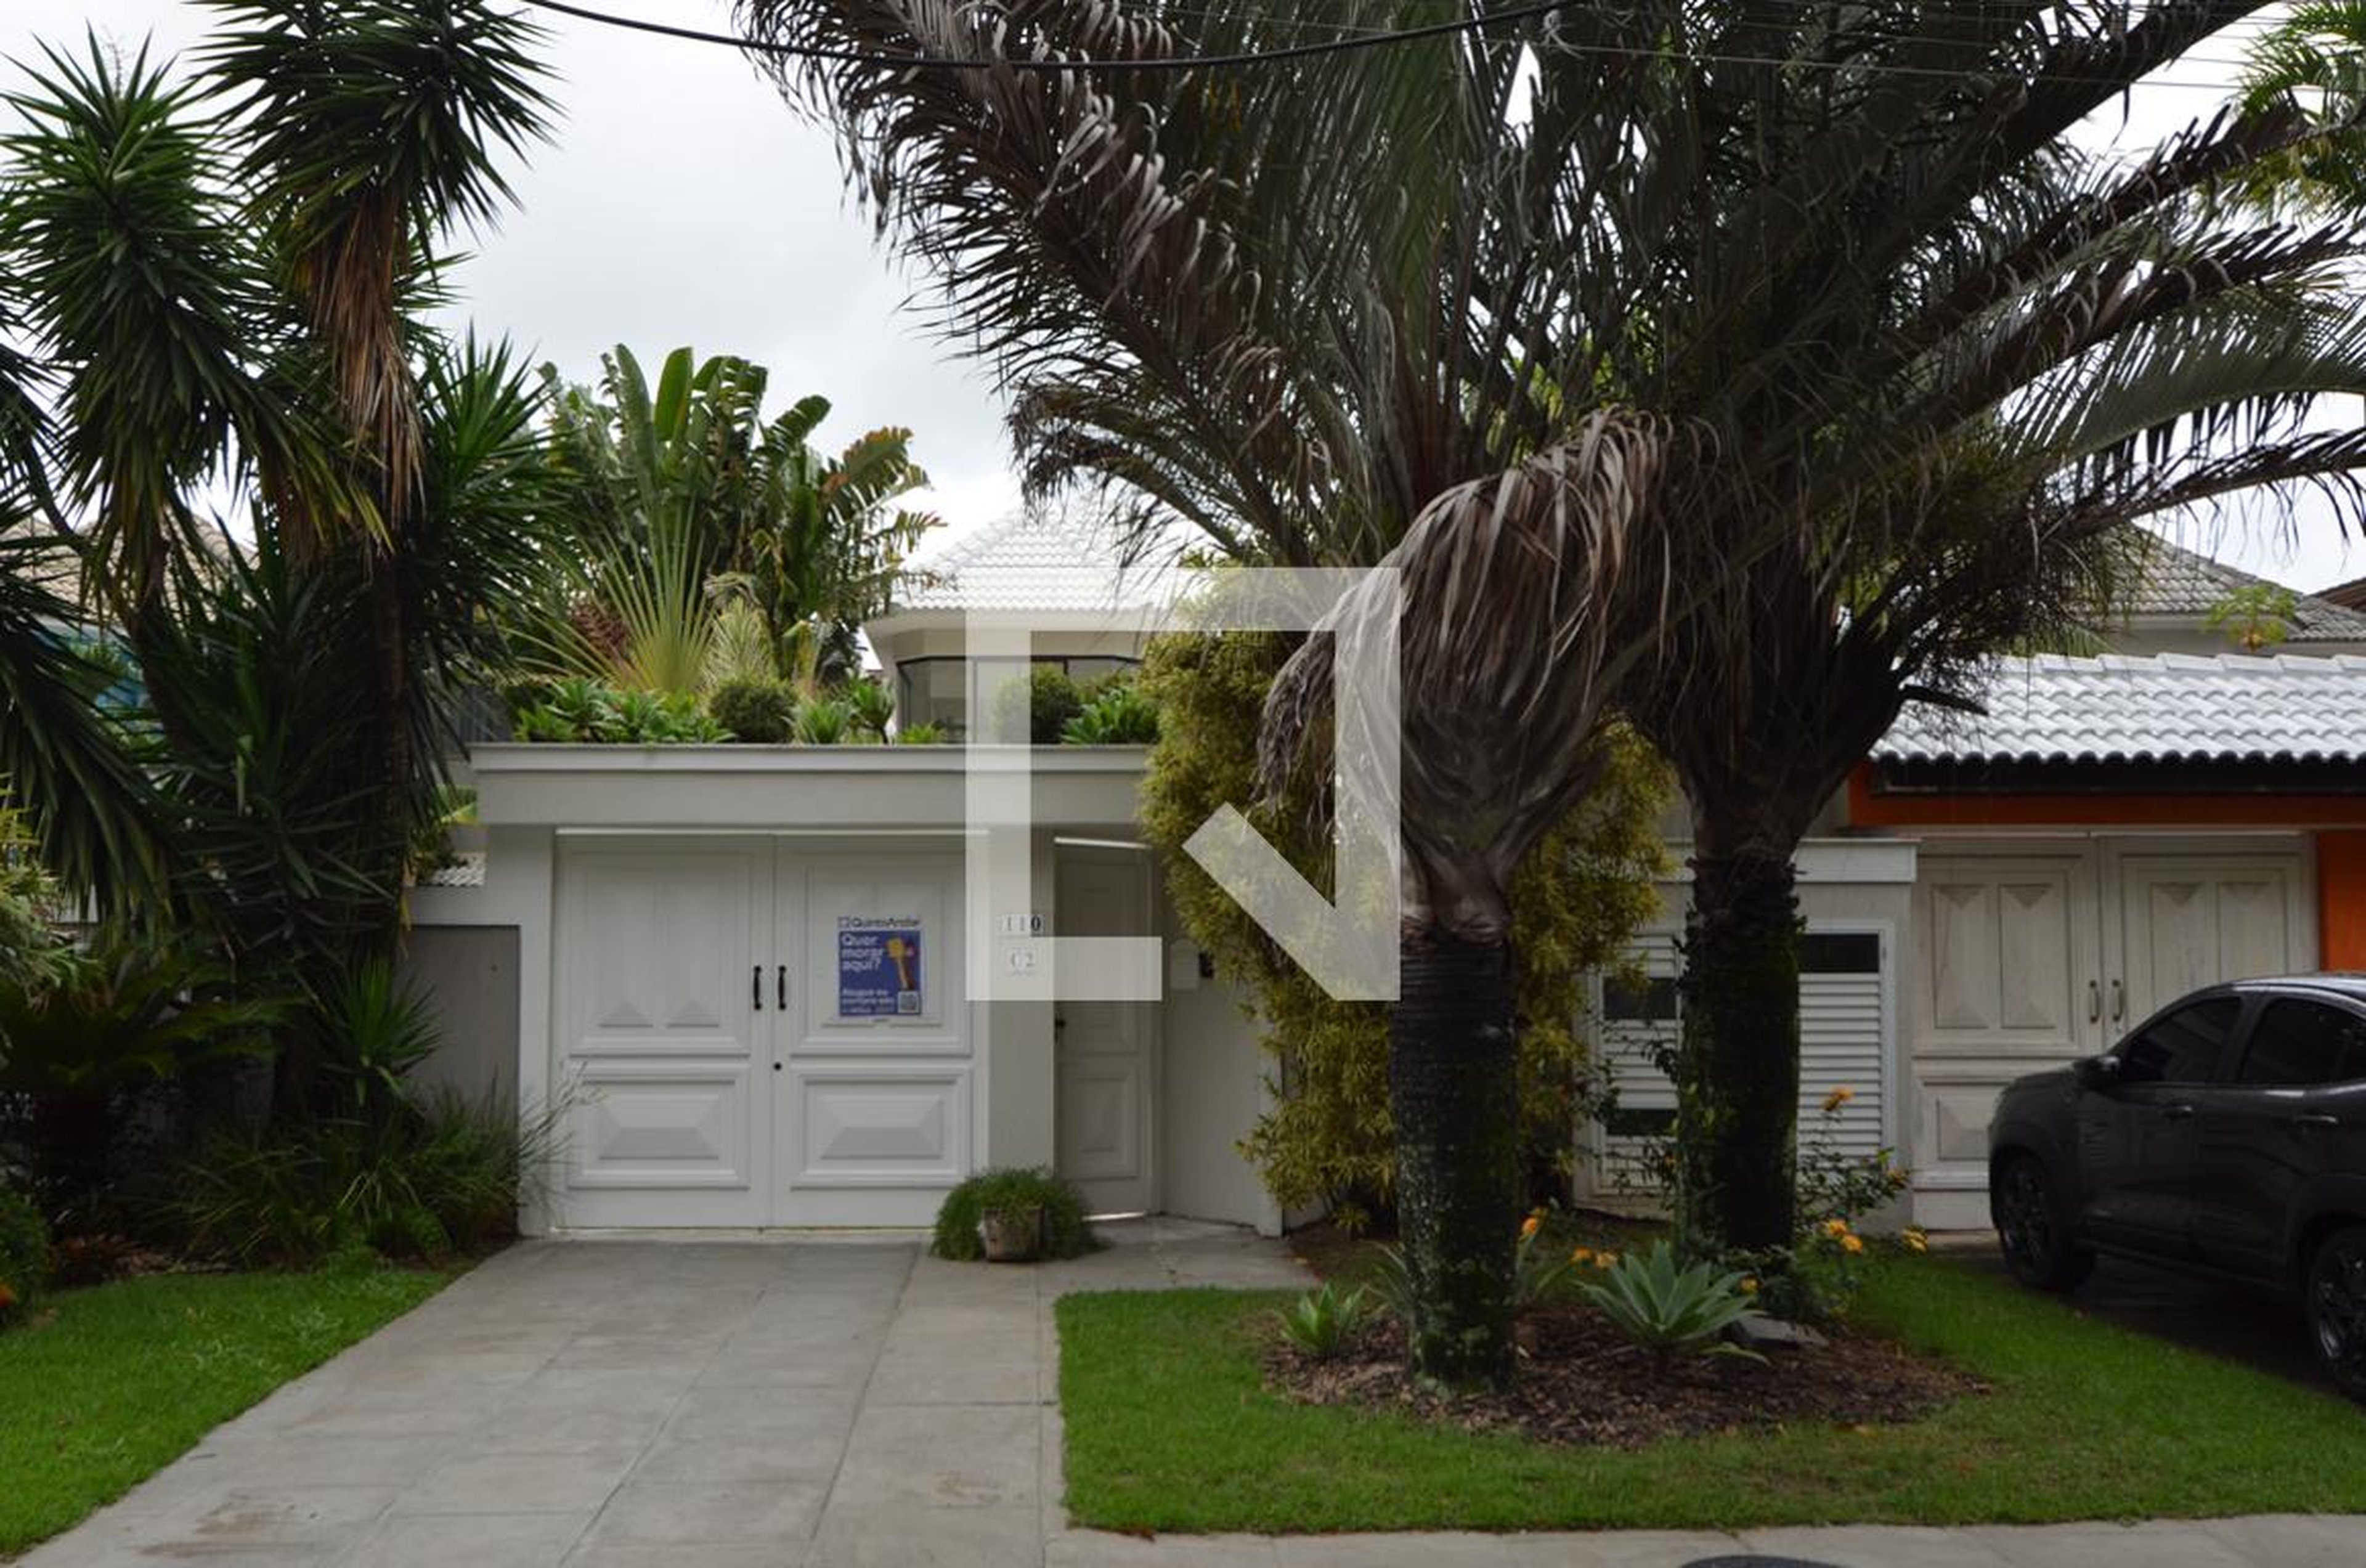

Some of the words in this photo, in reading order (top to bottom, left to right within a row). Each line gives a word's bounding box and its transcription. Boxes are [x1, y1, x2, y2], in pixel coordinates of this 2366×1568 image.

[843, 934, 879, 946] Quer
[843, 949, 884, 959] morar
[843, 959, 882, 972] aqui?
